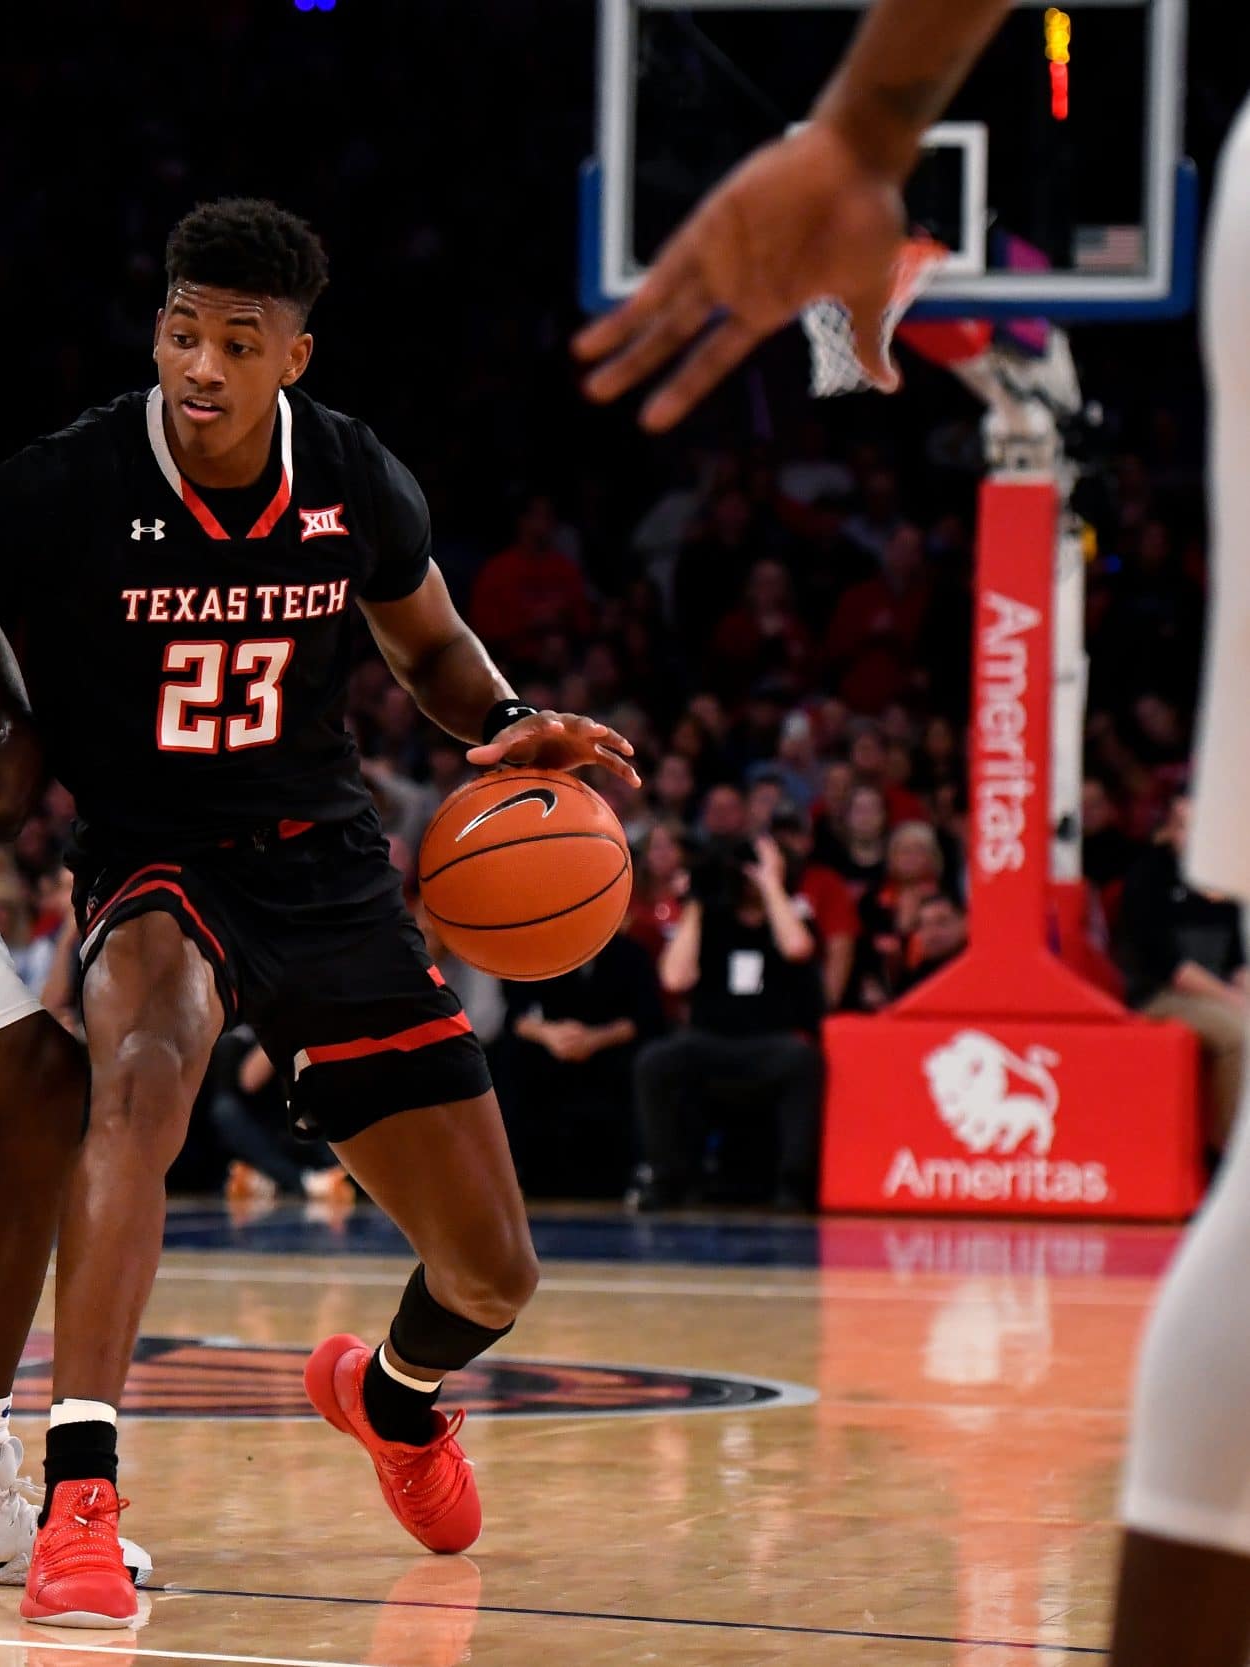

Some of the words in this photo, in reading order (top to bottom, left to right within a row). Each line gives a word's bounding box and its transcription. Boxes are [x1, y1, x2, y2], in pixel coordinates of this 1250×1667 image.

[121, 585, 250, 622] TEXAS
[255, 577, 350, 622] TECH
[156, 637, 296, 755] 23
[977, 589, 1043, 874] Ameritas
[882, 1146, 1108, 1203] Ameritas
